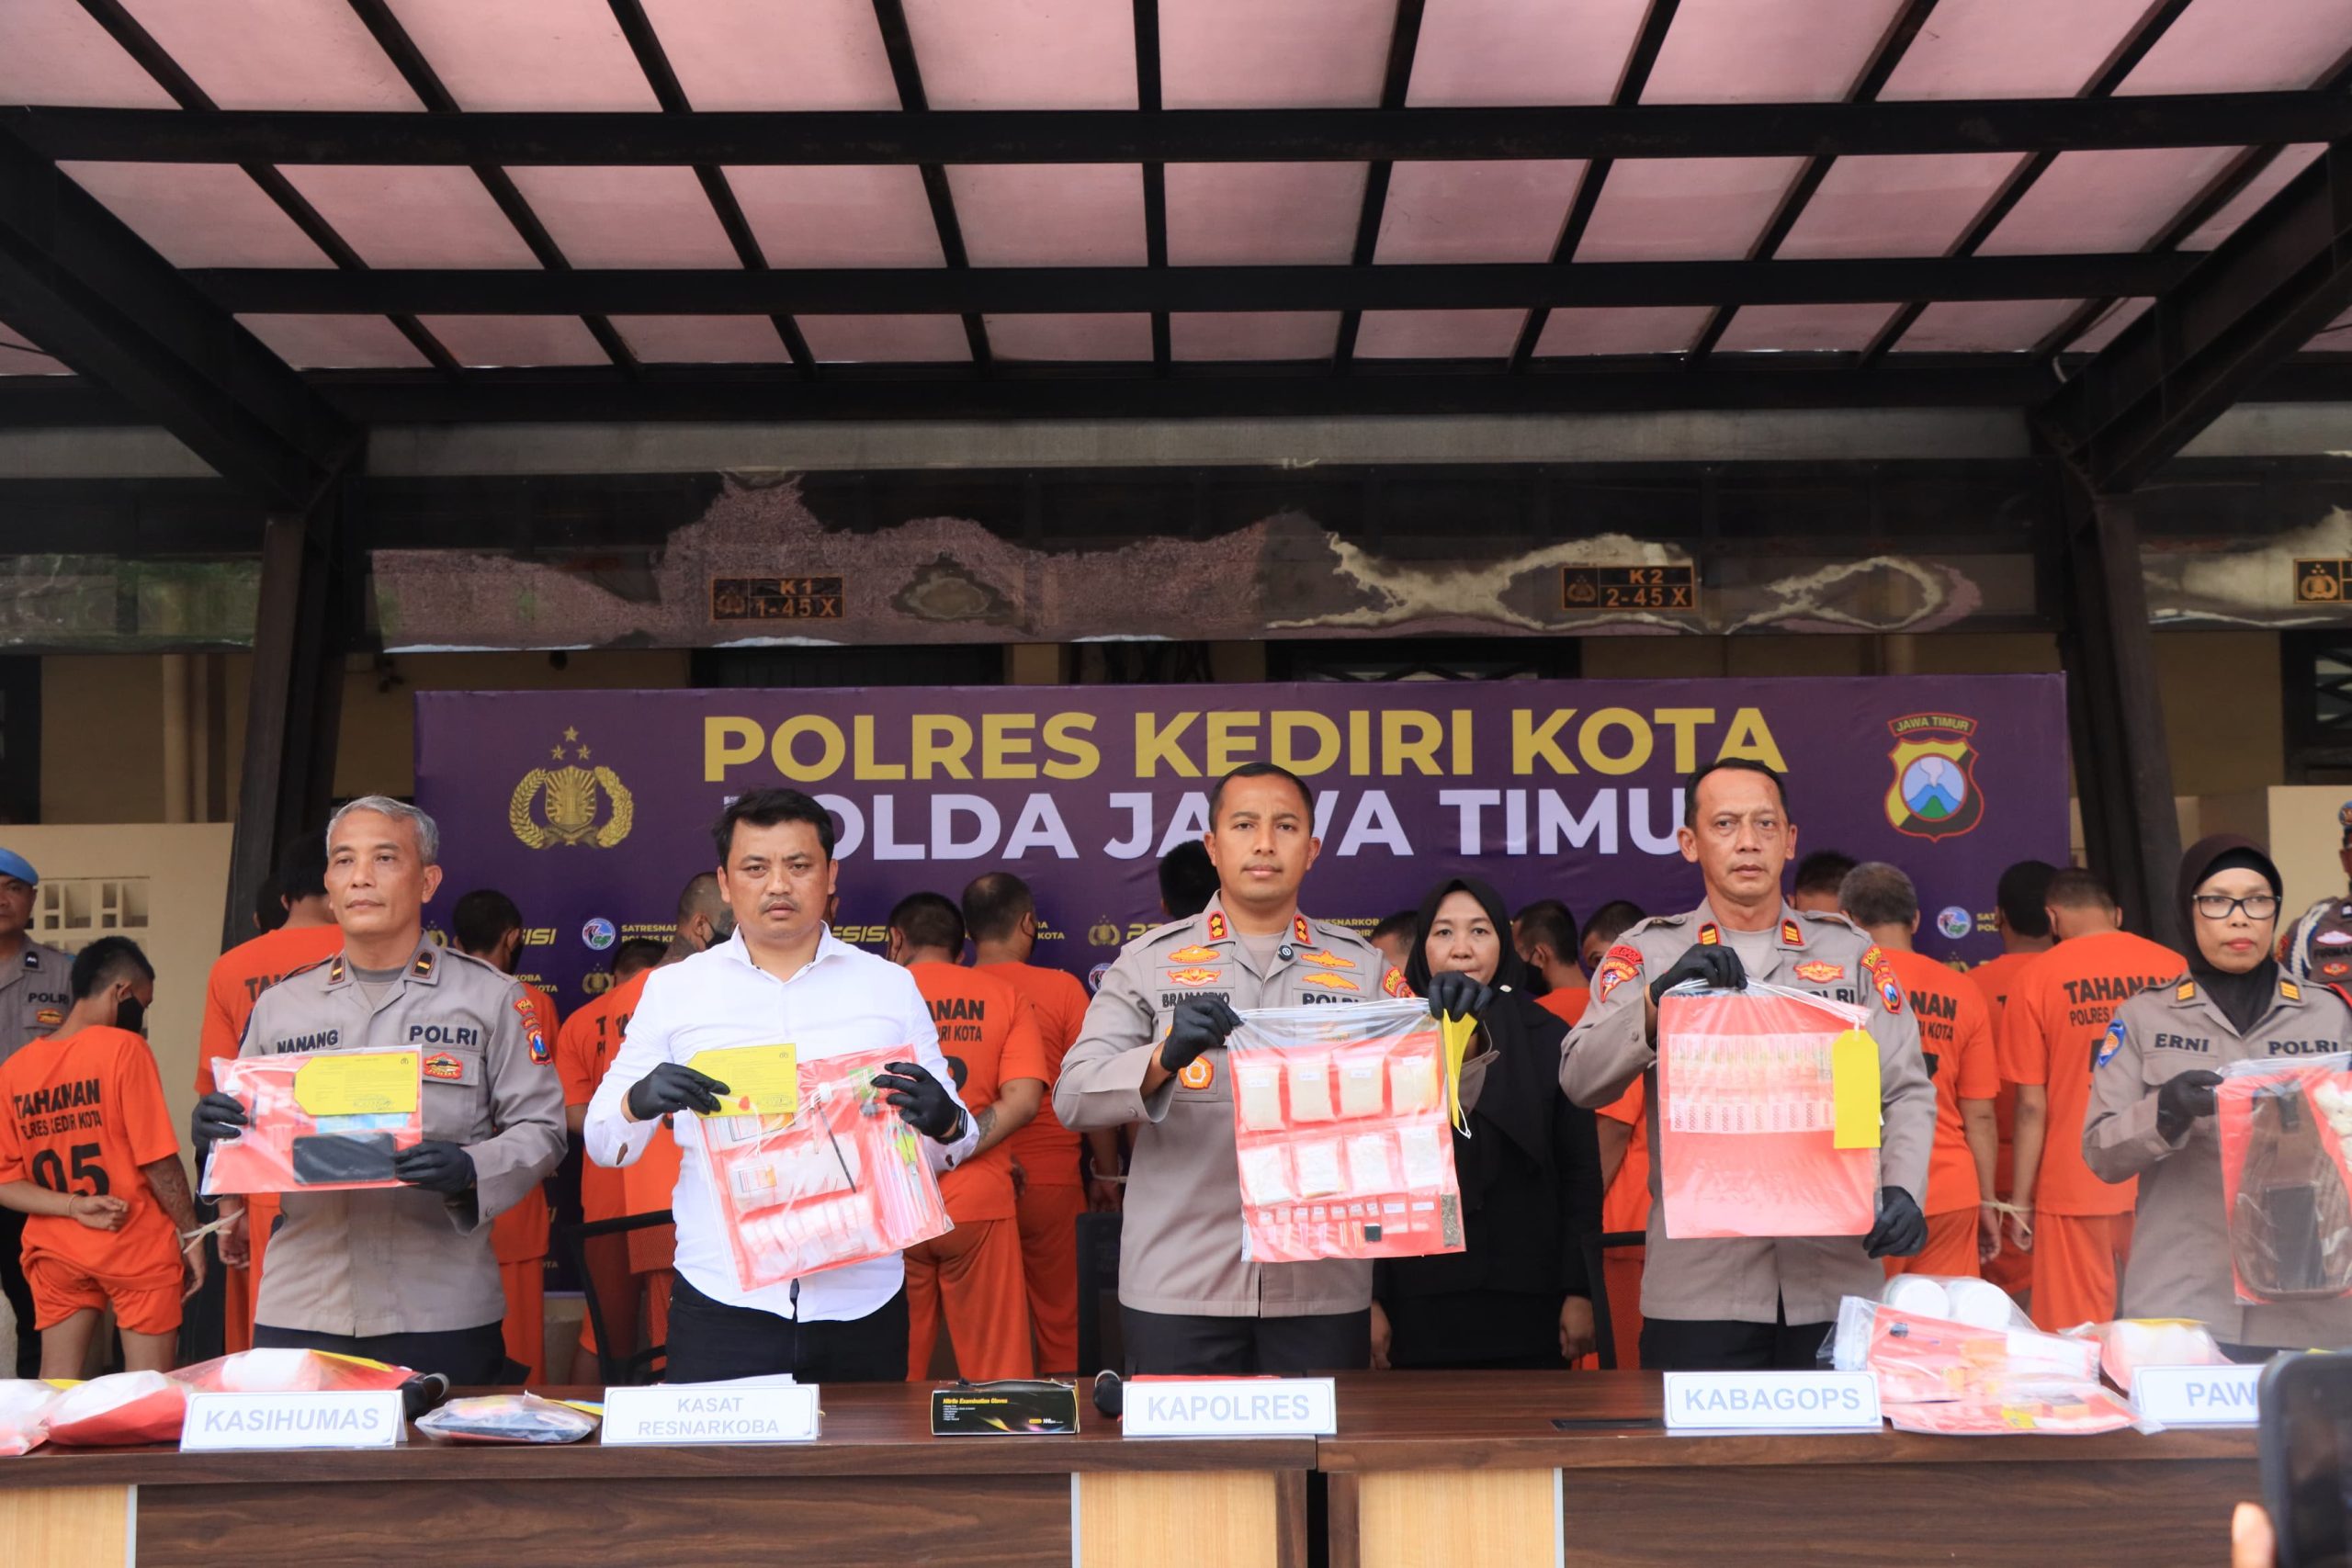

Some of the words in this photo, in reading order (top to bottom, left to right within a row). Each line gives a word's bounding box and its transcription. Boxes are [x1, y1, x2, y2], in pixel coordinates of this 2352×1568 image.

[1672, 587, 1688, 606] X
[820, 598, 836, 617] X
[1896, 716, 1929, 732] JAWA
[1931, 716, 1970, 732] TIMUR
[704, 713, 1101, 783] POLRES
[1135, 709, 1474, 778] KEDIRI
[1512, 706, 1790, 776] KOTA
[1102, 787, 1415, 860] JAA
[2069, 1006, 2110, 1027] POLRES
[277, 1030, 339, 1055] NANANG
[409, 1024, 478, 1046] POLRI
[954, 1025, 982, 1043] KOTA
[2154, 1033, 2210, 1053] ERNI
[2268, 1040, 2338, 1055] POLRI
[32, 1142, 110, 1197] 05
[677, 1397, 743, 1414] KASAT
[1148, 1393, 1310, 1422] KAPOLRES
[1684, 1387, 1861, 1411] KABAGOPS
[203, 1407, 380, 1432] KASIHUMAS
[638, 1419, 780, 1437] RESNARKOBA
